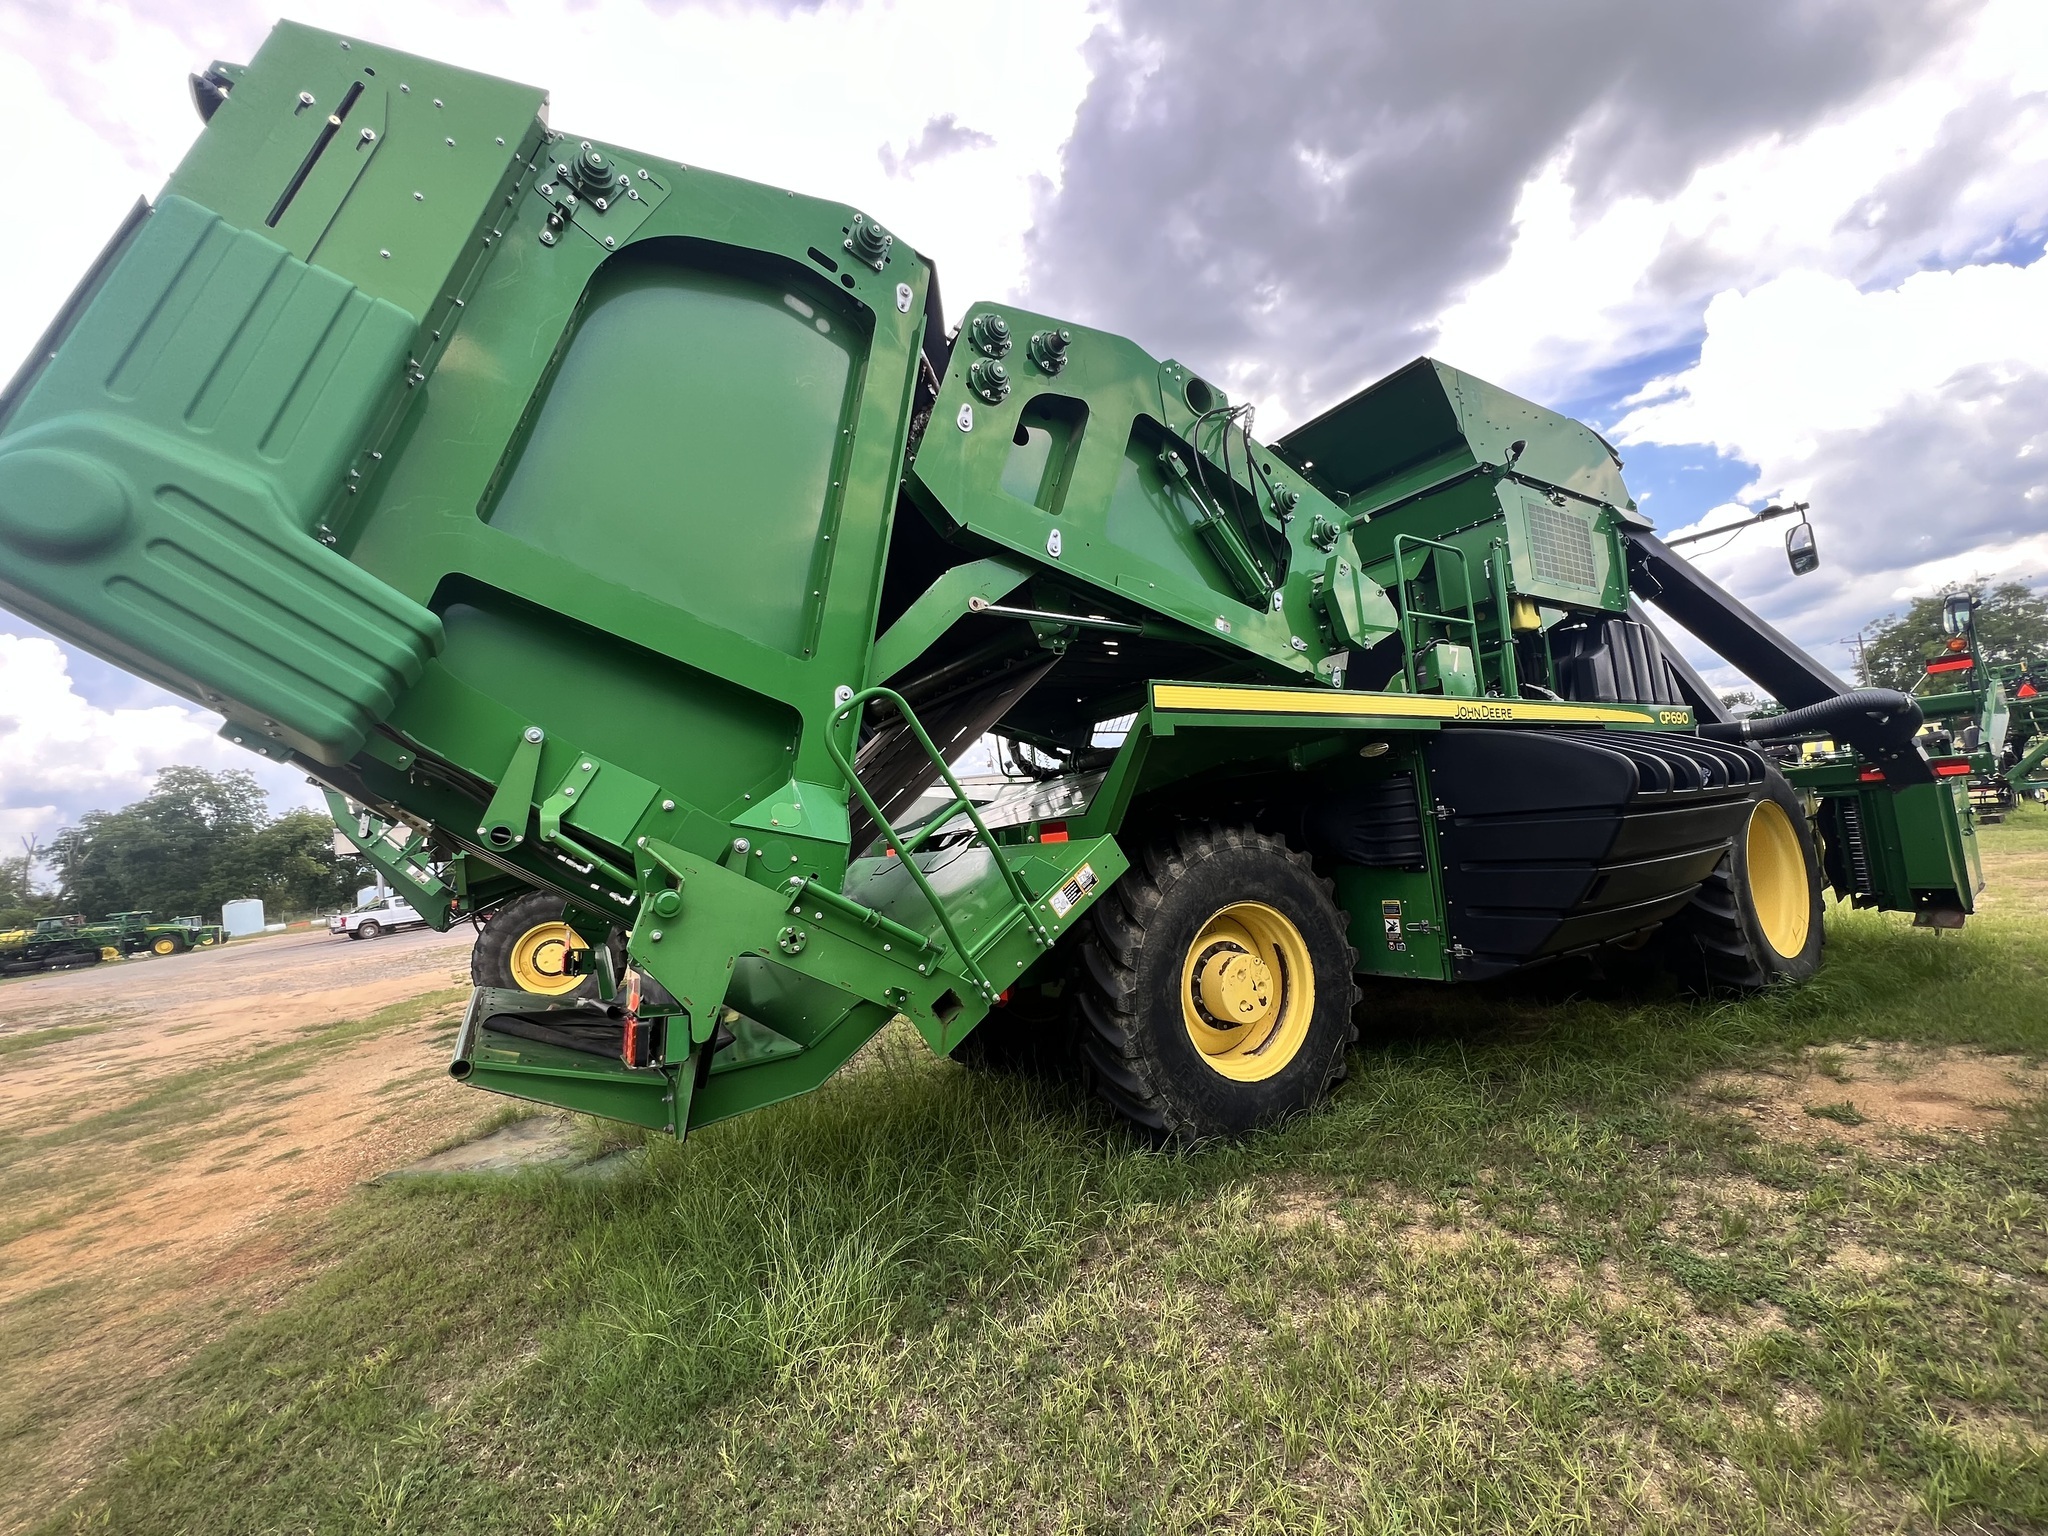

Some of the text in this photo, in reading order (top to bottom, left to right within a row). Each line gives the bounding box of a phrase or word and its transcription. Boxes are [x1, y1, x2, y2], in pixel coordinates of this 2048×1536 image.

[1449, 646, 1458, 672] 7
[1454, 704, 1513, 719] JOHN DEERE
[1659, 711, 1689, 724] CP690
